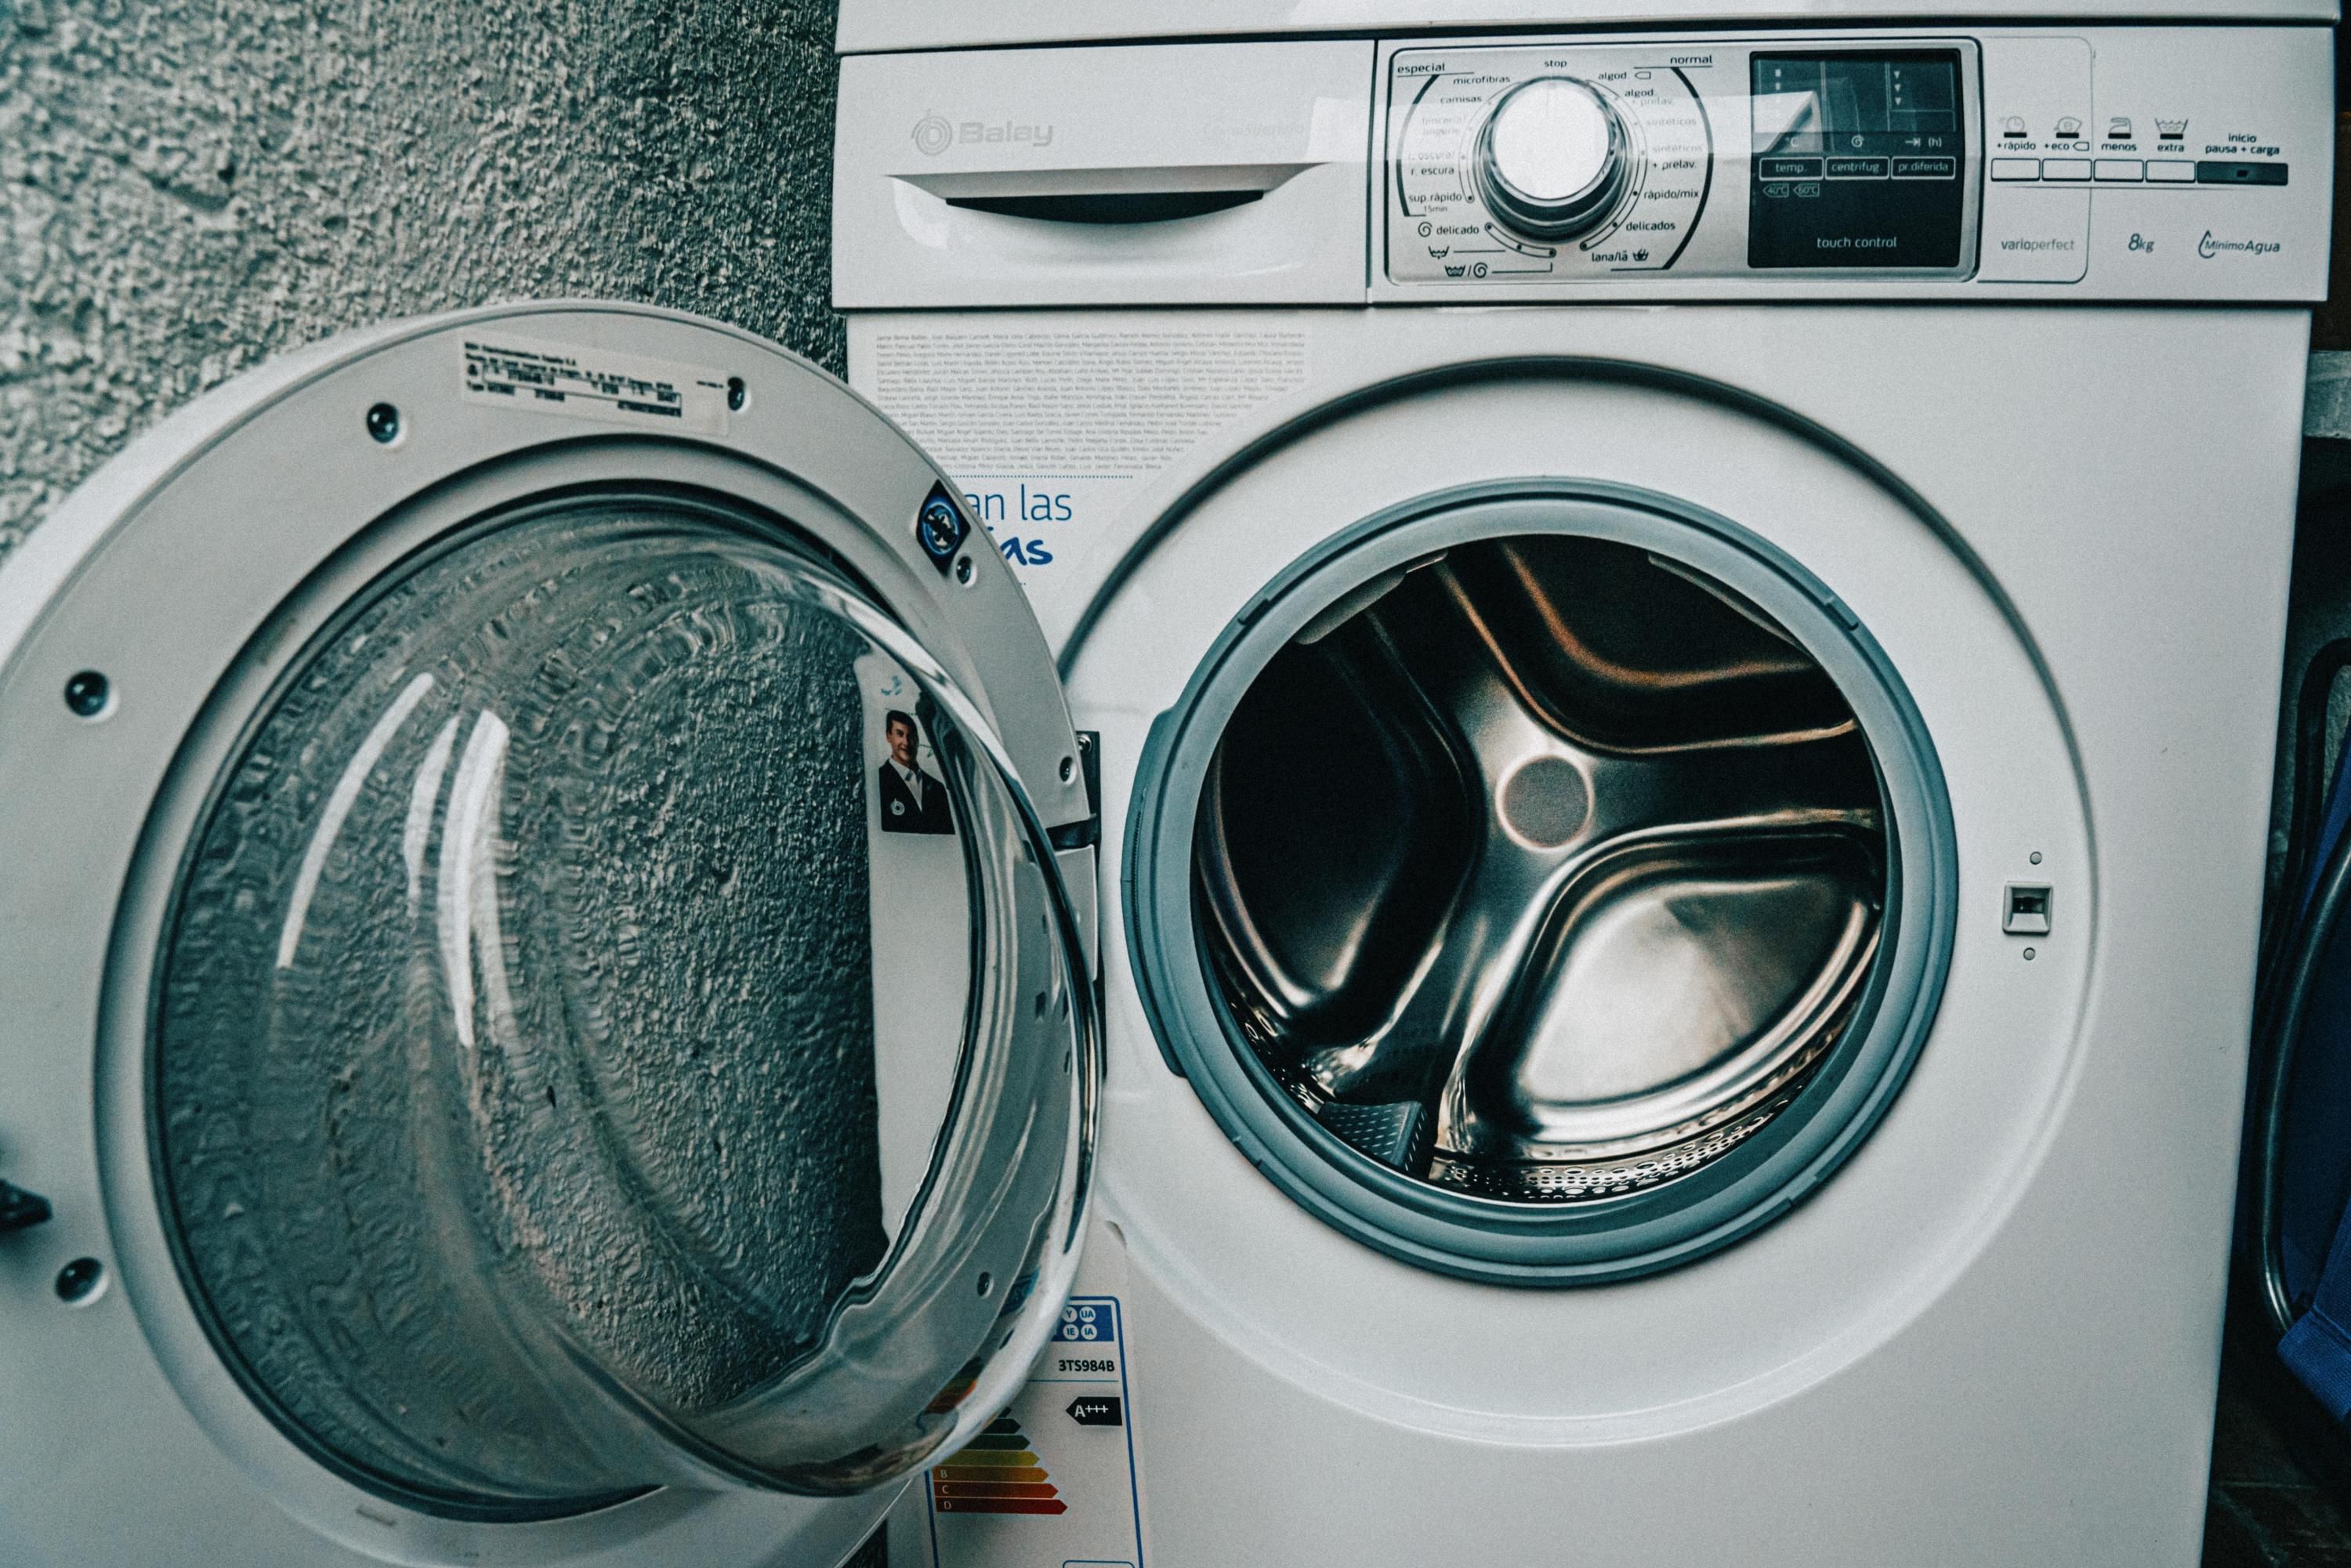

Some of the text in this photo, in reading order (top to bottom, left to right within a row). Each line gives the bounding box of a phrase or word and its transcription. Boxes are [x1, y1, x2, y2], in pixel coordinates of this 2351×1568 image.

[1544, 59, 1567, 68] stop
[1670, 55, 1713, 64] normal
[1397, 63, 1445, 74] especial
[1453, 75, 1511, 85] microfibras
[1440, 96, 1482, 104] camisas
[958, 121, 1054, 147] Balay
[2205, 145, 2237, 154] pausa
[2250, 146, 2280, 157] carga
[1421, 167, 1455, 176] escura
[1436, 225, 1480, 235] delicado
[1625, 220, 1675, 231] delicados
[1817, 236, 1897, 248] touch control
[2001, 237, 2076, 252] varioperfect
[2128, 233, 2154, 253] 8kg
[1592, 250, 1628, 263] lana/lã
[1020, 483, 1073, 521] las
[1067, 1327, 1076, 1336] IE
[1085, 1327, 1094, 1336] IA
[1058, 1360, 1115, 1372] 3TS984B
[1074, 1404, 1109, 1418] A+++
[940, 1469, 947, 1479] B
[942, 1485, 949, 1494] C
[944, 1501, 951, 1510] D
